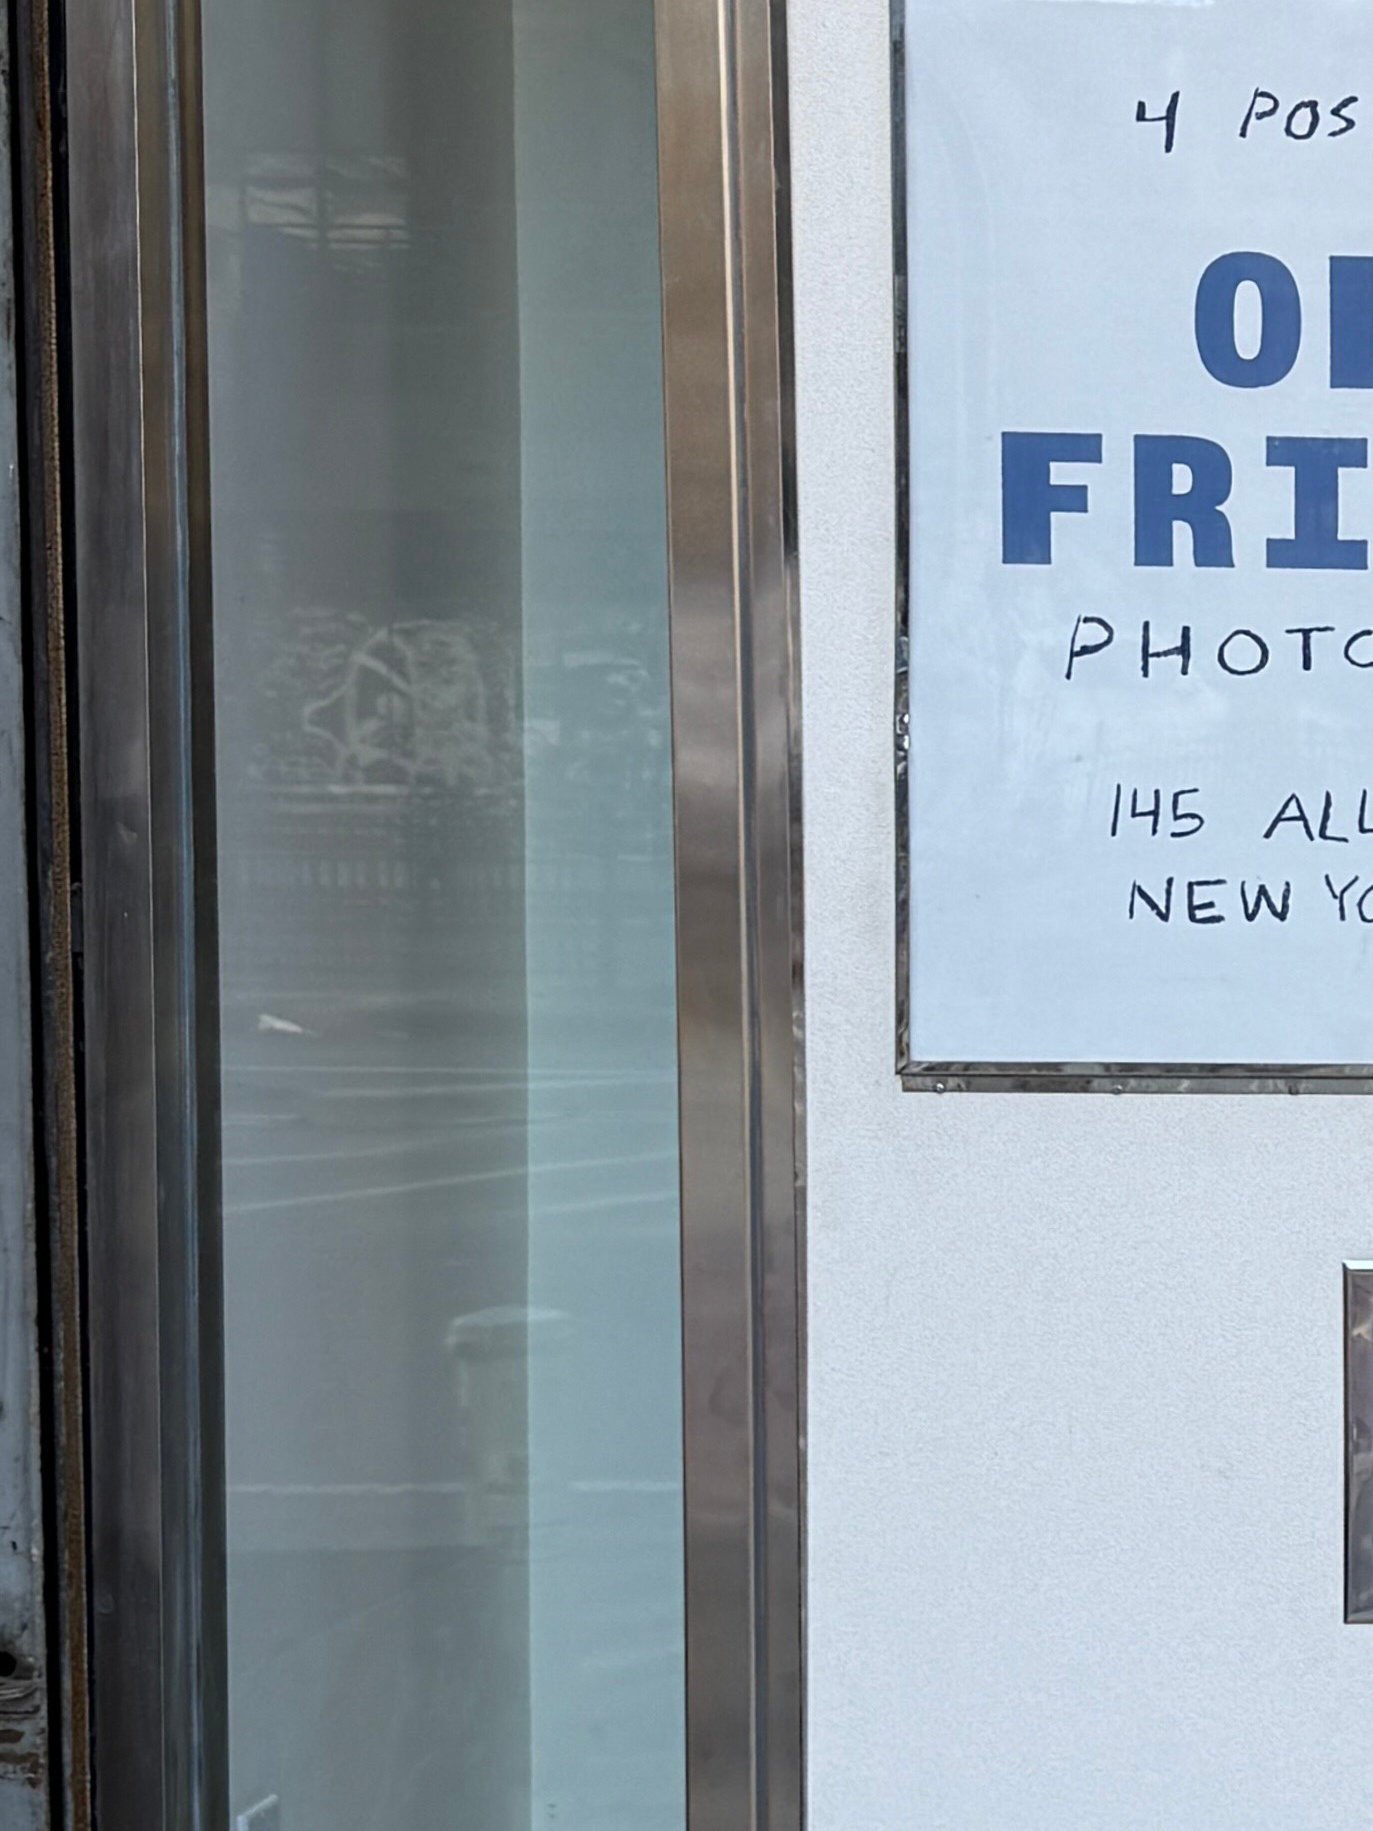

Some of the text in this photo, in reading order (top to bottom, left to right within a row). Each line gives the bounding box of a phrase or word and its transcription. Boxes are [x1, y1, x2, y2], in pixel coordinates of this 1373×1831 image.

[1134, 89, 1182, 155] 4
[1109, 782, 1206, 841] 145
[1127, 875, 1292, 928] NEW
